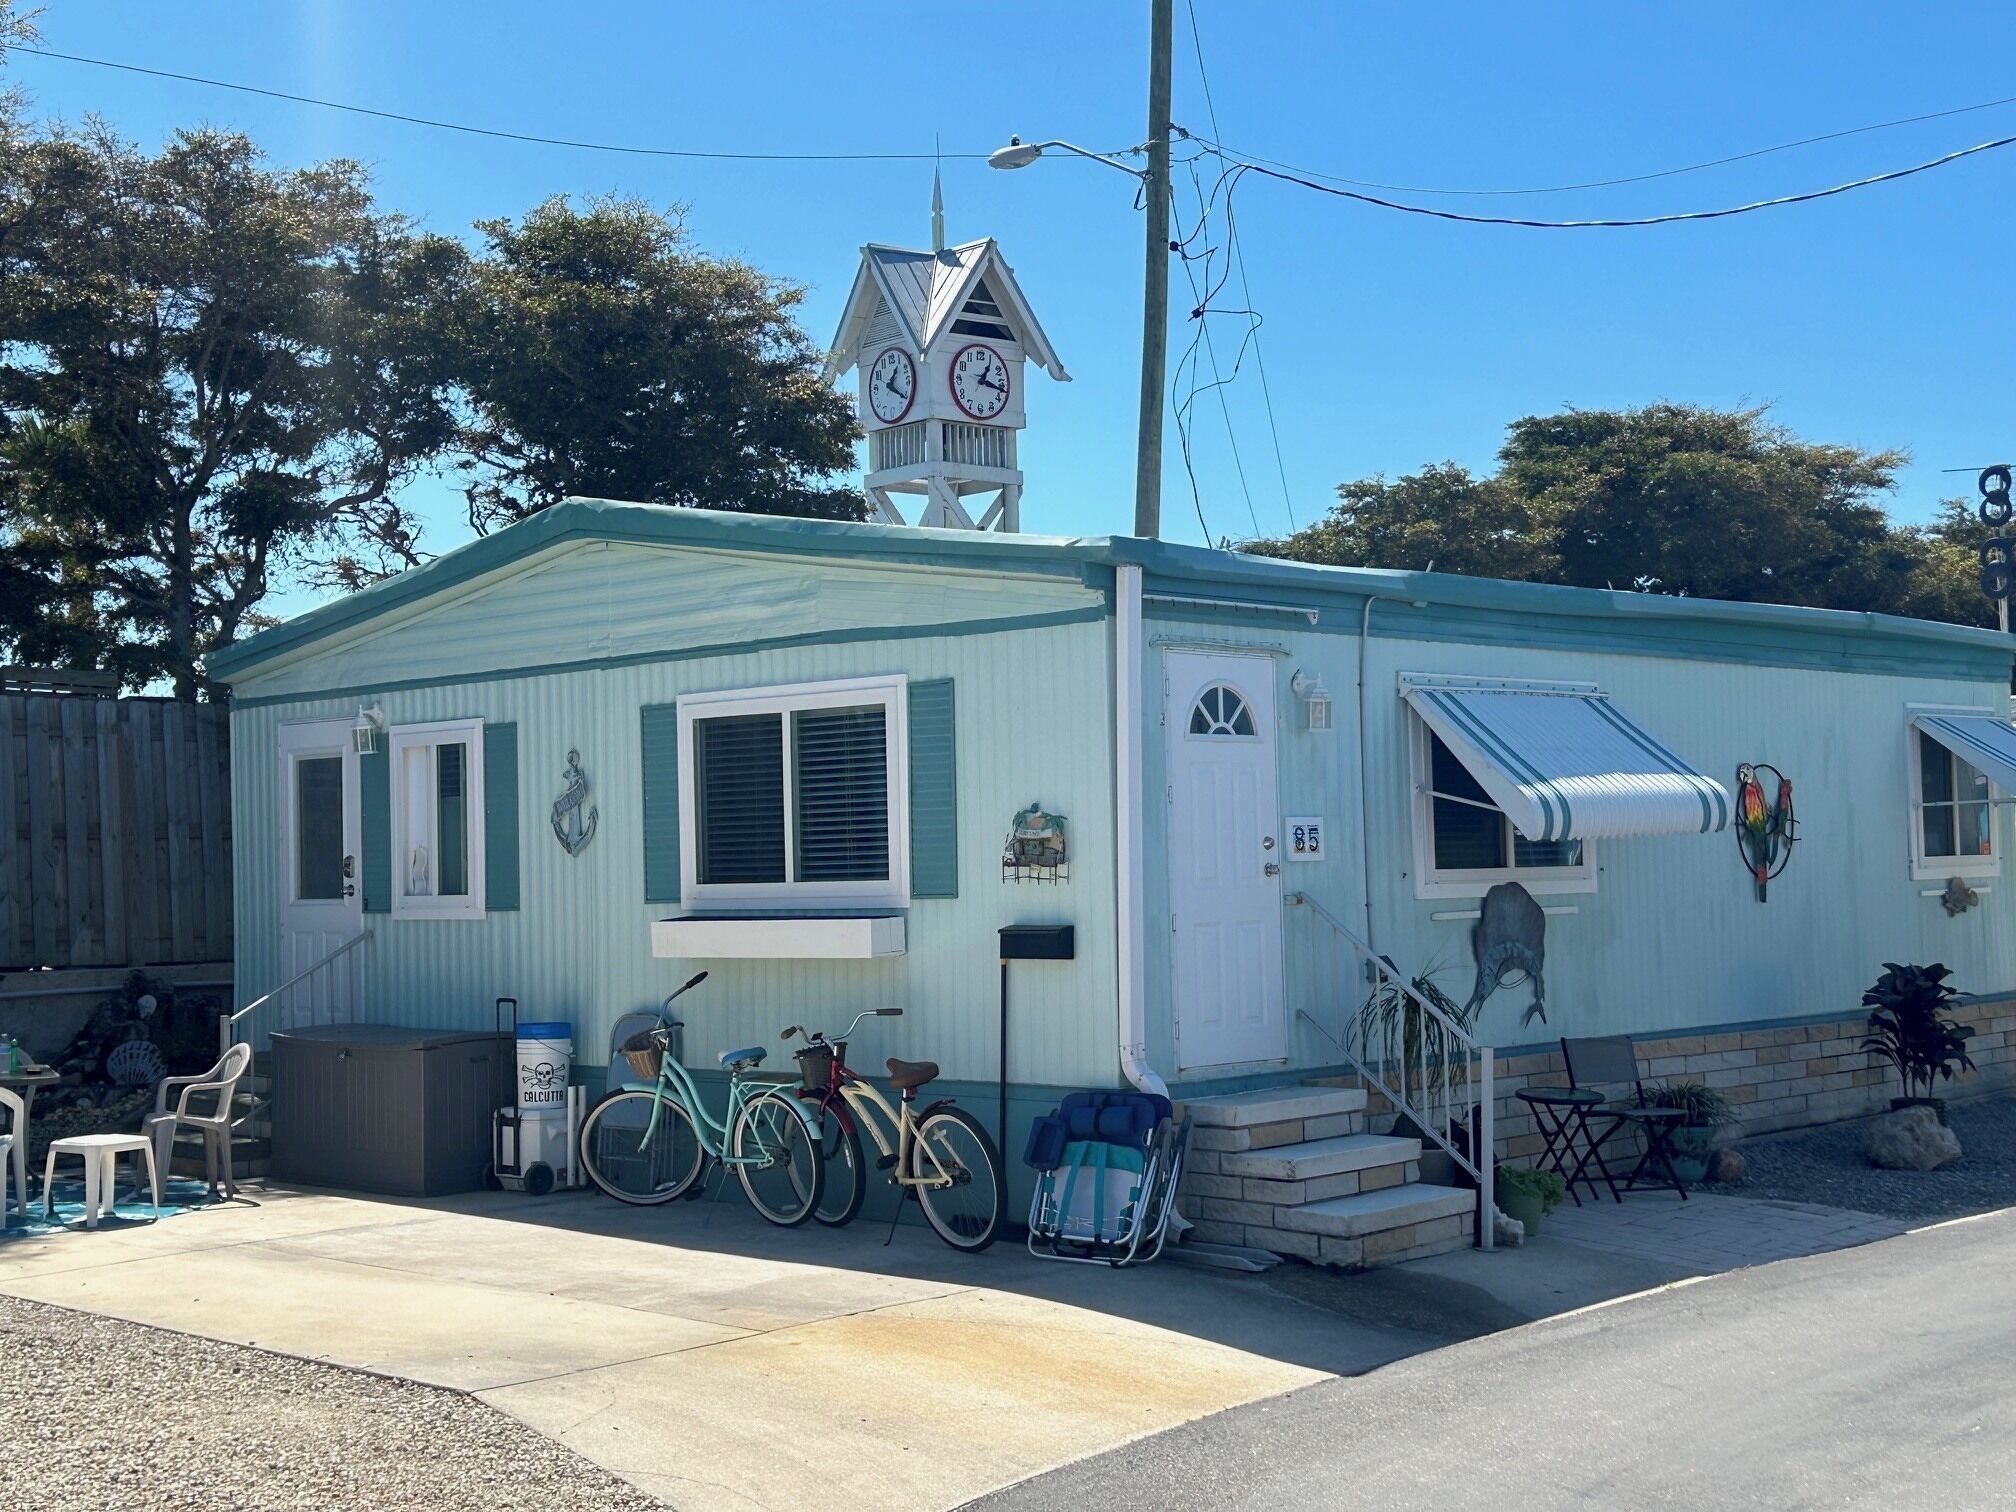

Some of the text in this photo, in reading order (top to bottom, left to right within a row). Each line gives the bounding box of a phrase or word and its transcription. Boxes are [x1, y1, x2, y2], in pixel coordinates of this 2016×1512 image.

[967, 352, 972, 362] 11
[976, 350, 985, 361] 12
[881, 358, 886, 369] 11
[960, 361, 967, 371] 10
[995, 365, 1002, 376] 2
[960, 388, 965, 399] 8
[967, 399, 973, 410] 7
[1294, 827, 1319, 851] 85
[524, 1091, 563, 1102] CALCUTTA
